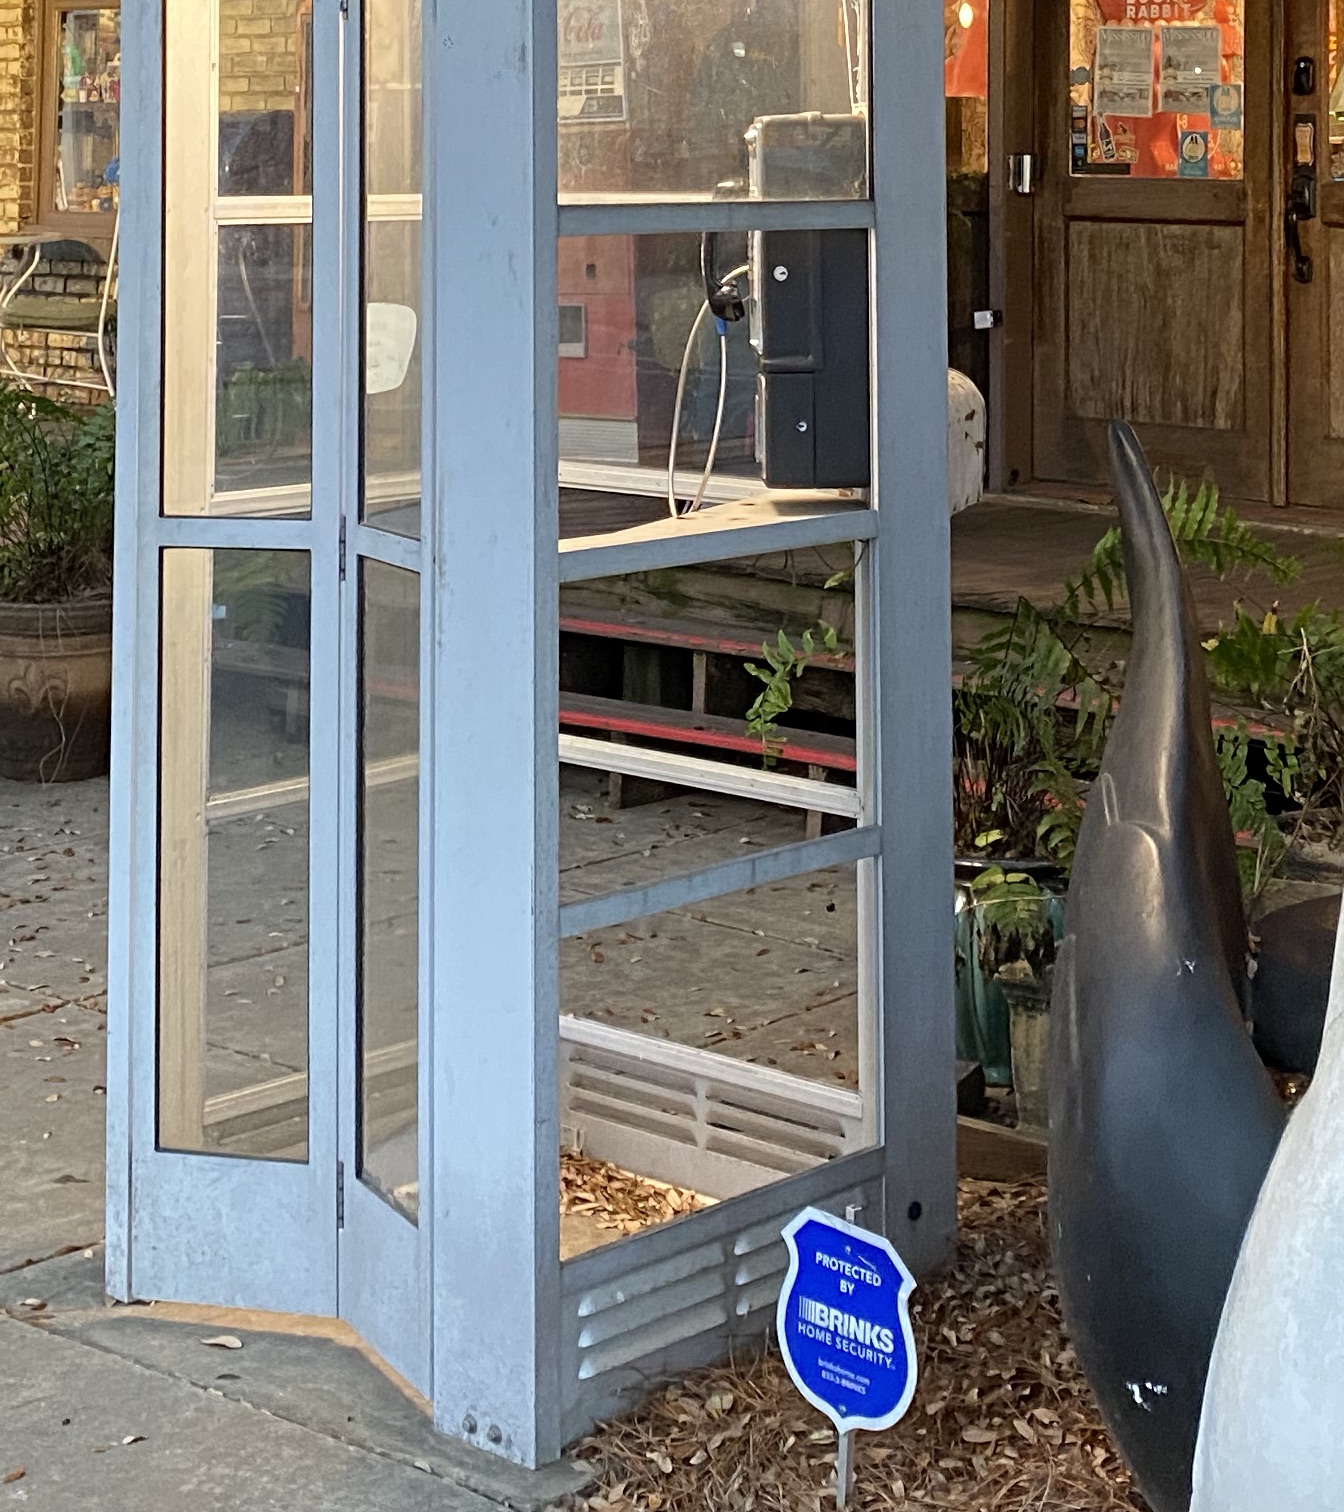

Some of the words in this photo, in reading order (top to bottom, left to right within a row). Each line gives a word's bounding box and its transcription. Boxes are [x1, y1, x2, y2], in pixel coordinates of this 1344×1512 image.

[1126, 4, 1191, 19] RABBIT
[815, 1251, 882, 1287] PROTECTED
[839, 1279, 856, 1296] BY
[797, 1321, 833, 1347] HOME
[835, 1336, 894, 1369] SECURITY
[814, 1302, 895, 1353] BRINKS
